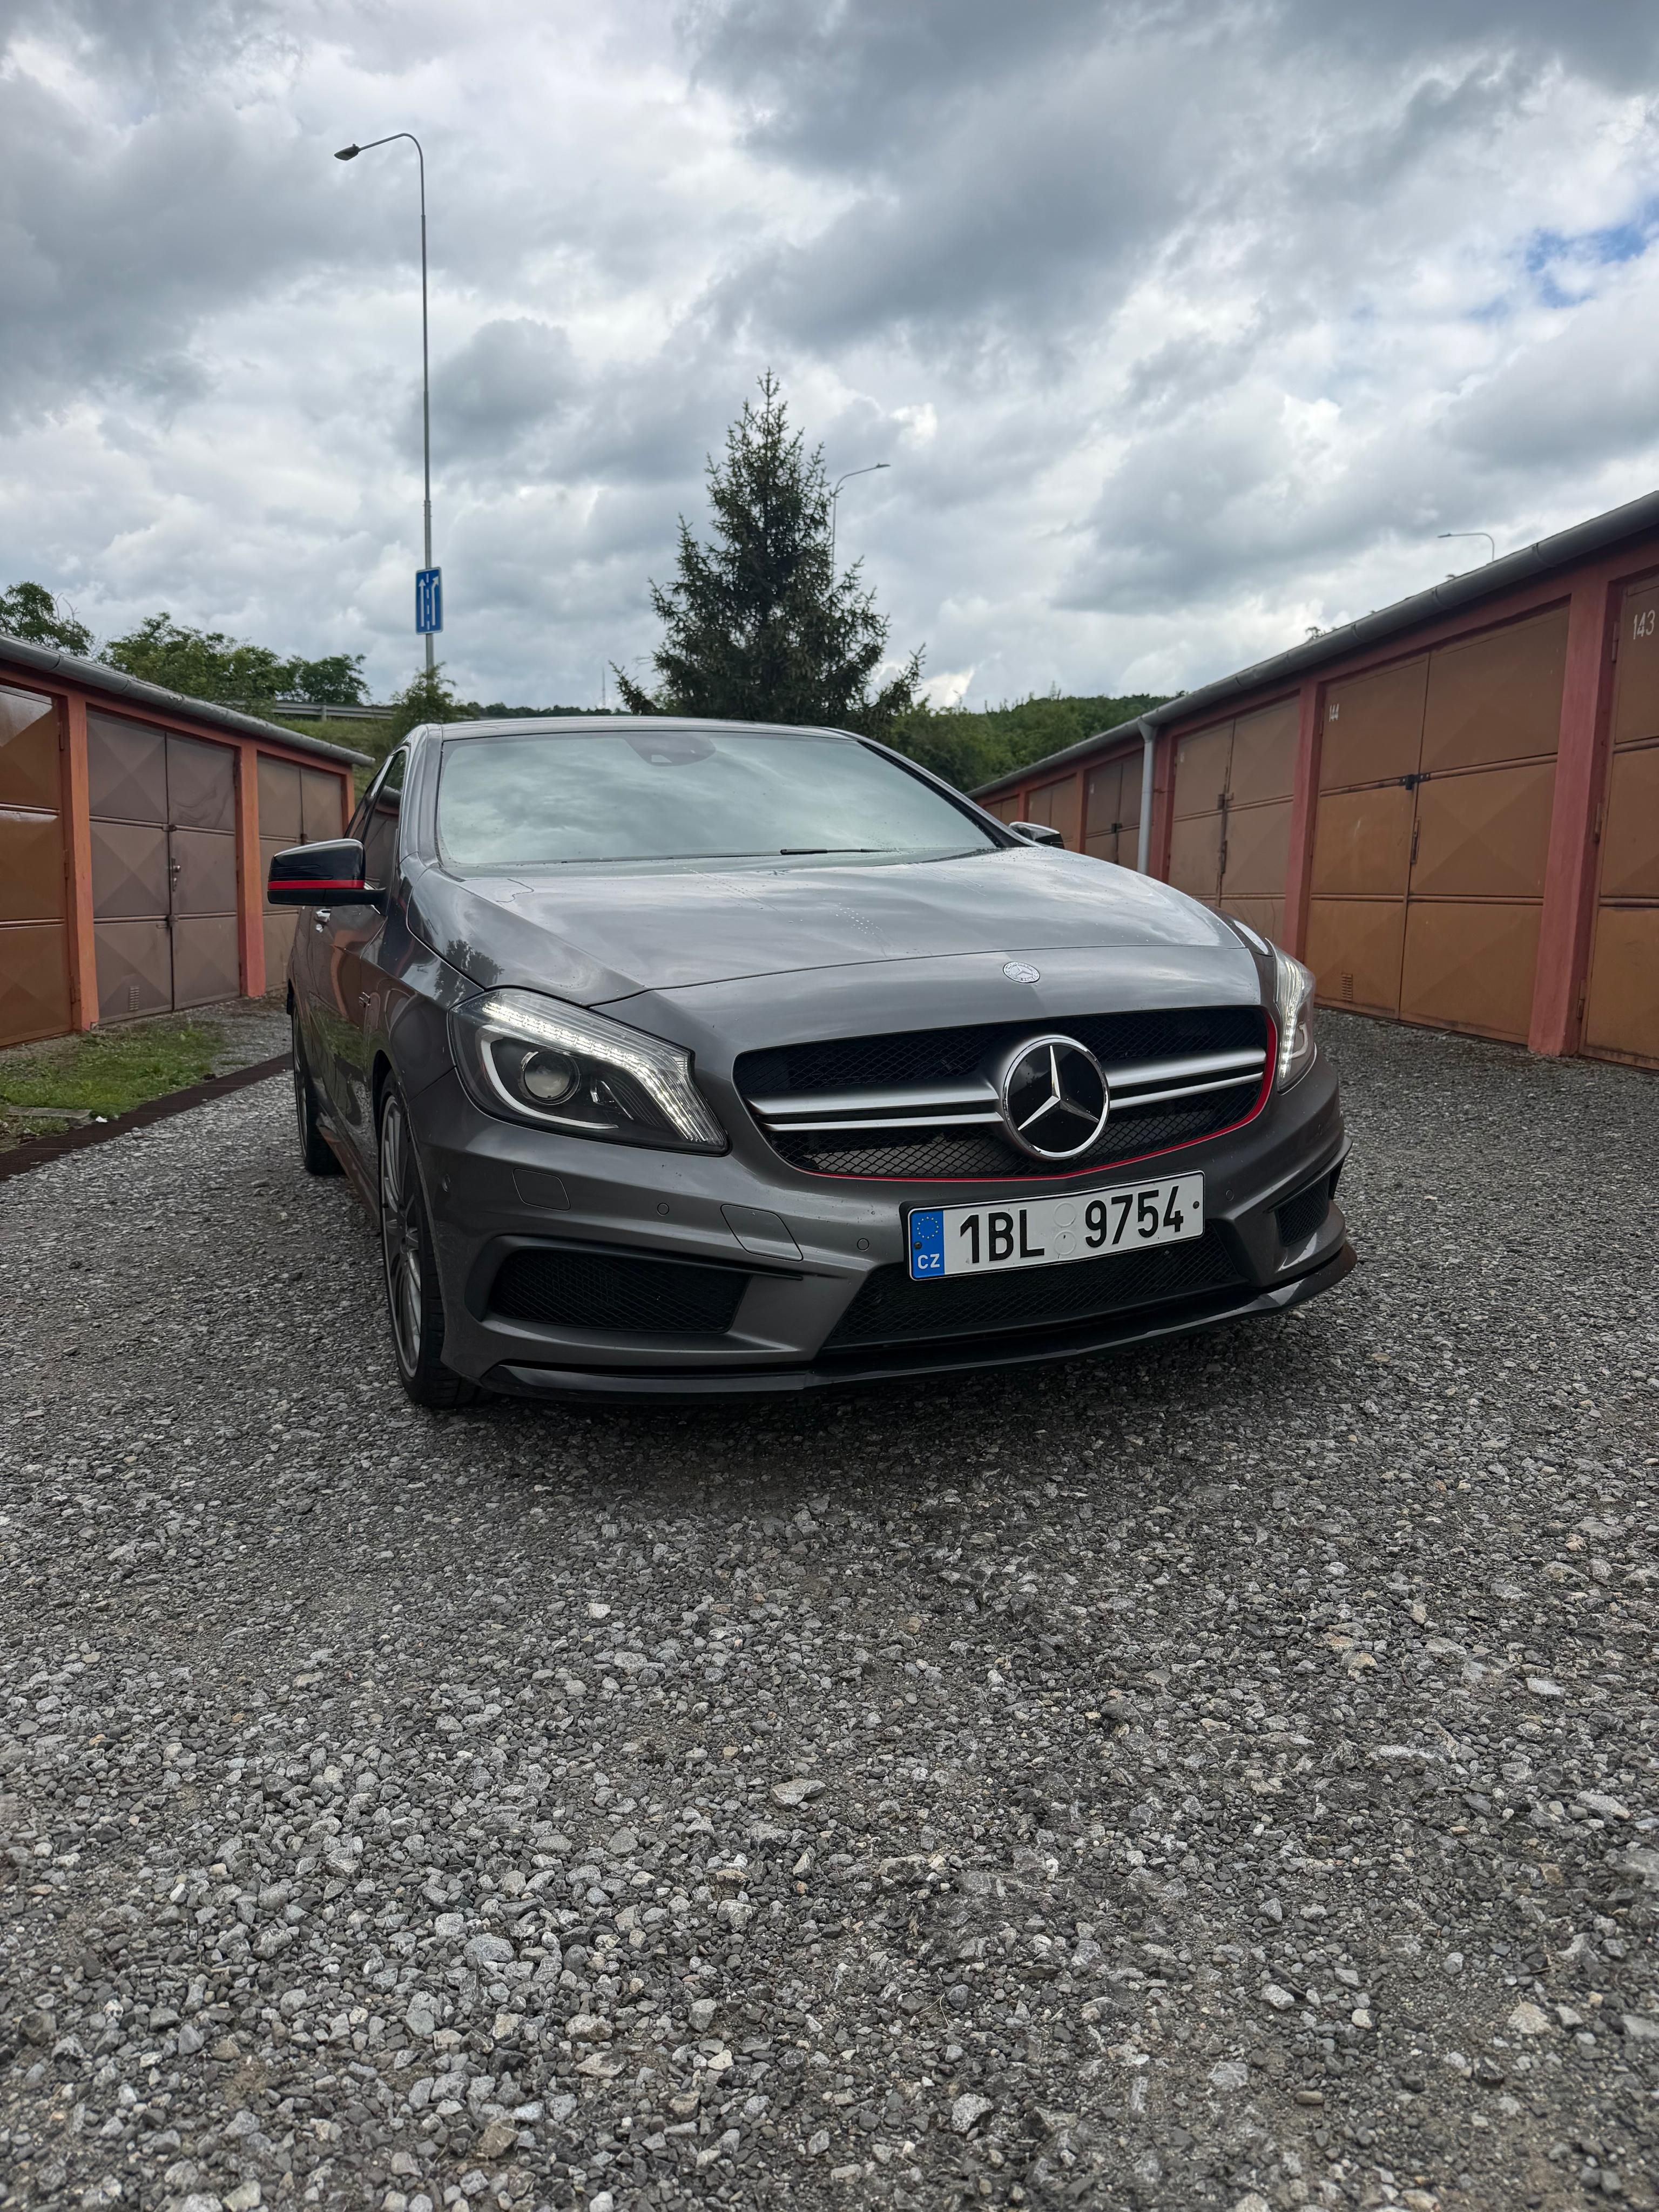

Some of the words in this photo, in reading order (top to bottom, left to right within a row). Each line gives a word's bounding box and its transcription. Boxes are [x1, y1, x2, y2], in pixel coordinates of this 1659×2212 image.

[1633, 610, 1655, 639] 143
[960, 1209, 1045, 1264] 1BL
[1085, 1186, 1184, 1247] 9754
[918, 1253, 940, 1270] CZ
